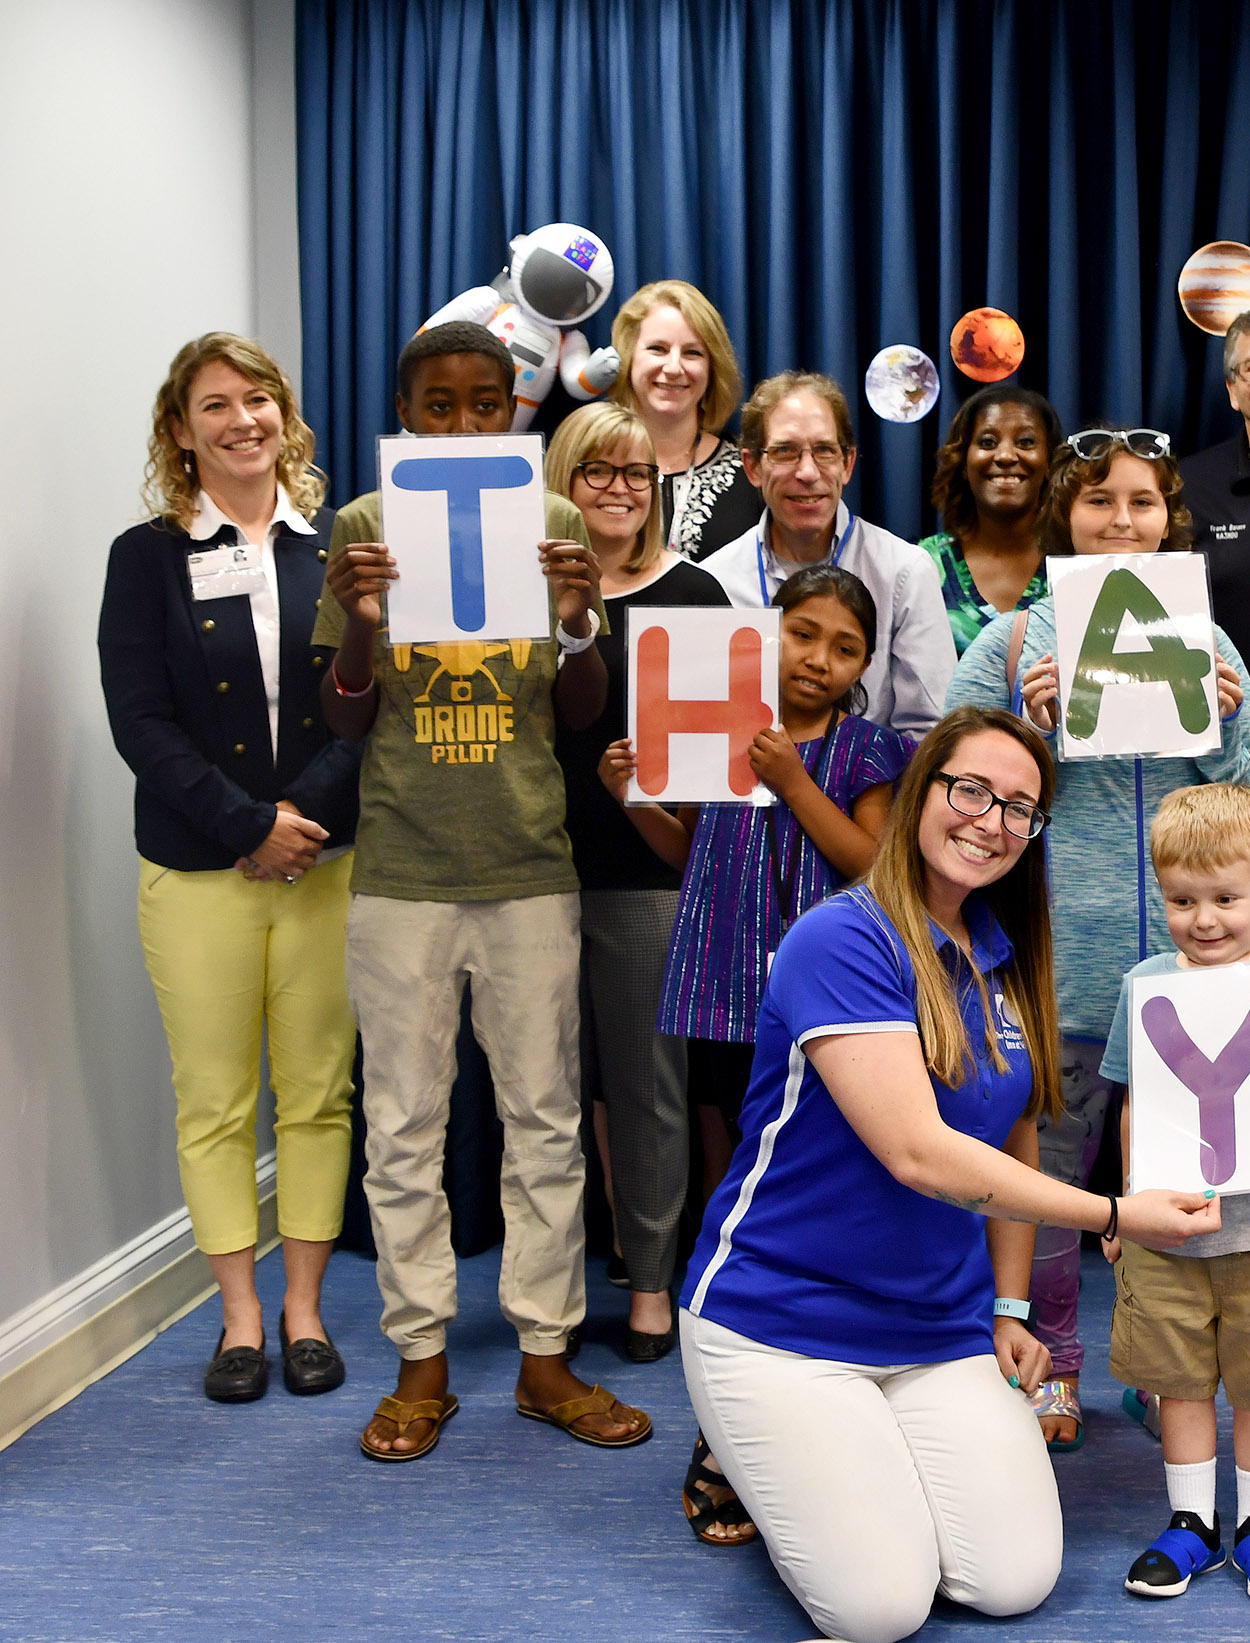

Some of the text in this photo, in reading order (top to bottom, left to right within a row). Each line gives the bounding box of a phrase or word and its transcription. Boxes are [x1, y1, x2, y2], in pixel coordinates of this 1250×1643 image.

[391, 455, 534, 633] T
[413, 704, 514, 743] DRONE
[635, 625, 774, 797] H
[1066, 568, 1212, 741] A
[431, 743, 498, 764] PILOT
